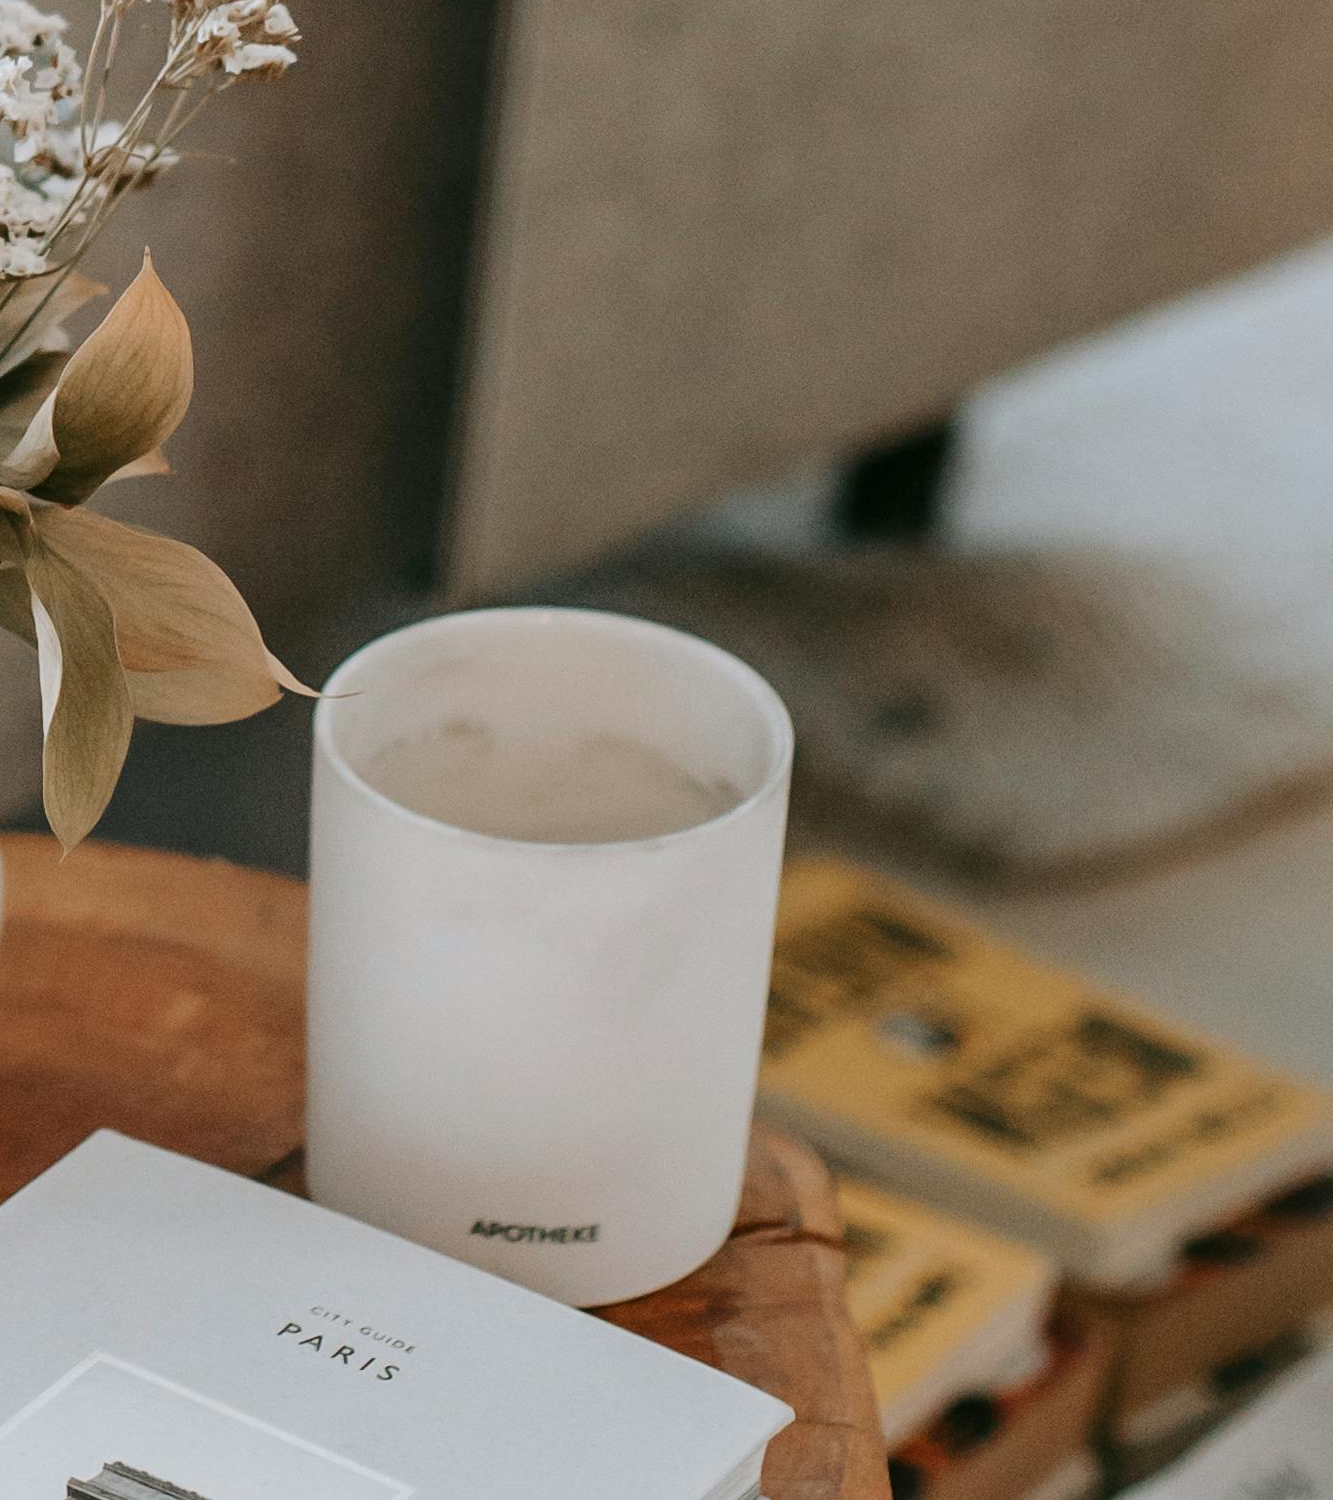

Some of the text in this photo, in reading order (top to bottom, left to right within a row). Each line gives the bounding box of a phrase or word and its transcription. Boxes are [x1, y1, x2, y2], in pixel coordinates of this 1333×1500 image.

[470, 1217, 601, 1245] APOTHEKE
[276, 1322, 400, 1381] PARIS
[310, 1305, 417, 1354] CITY GUIDE
